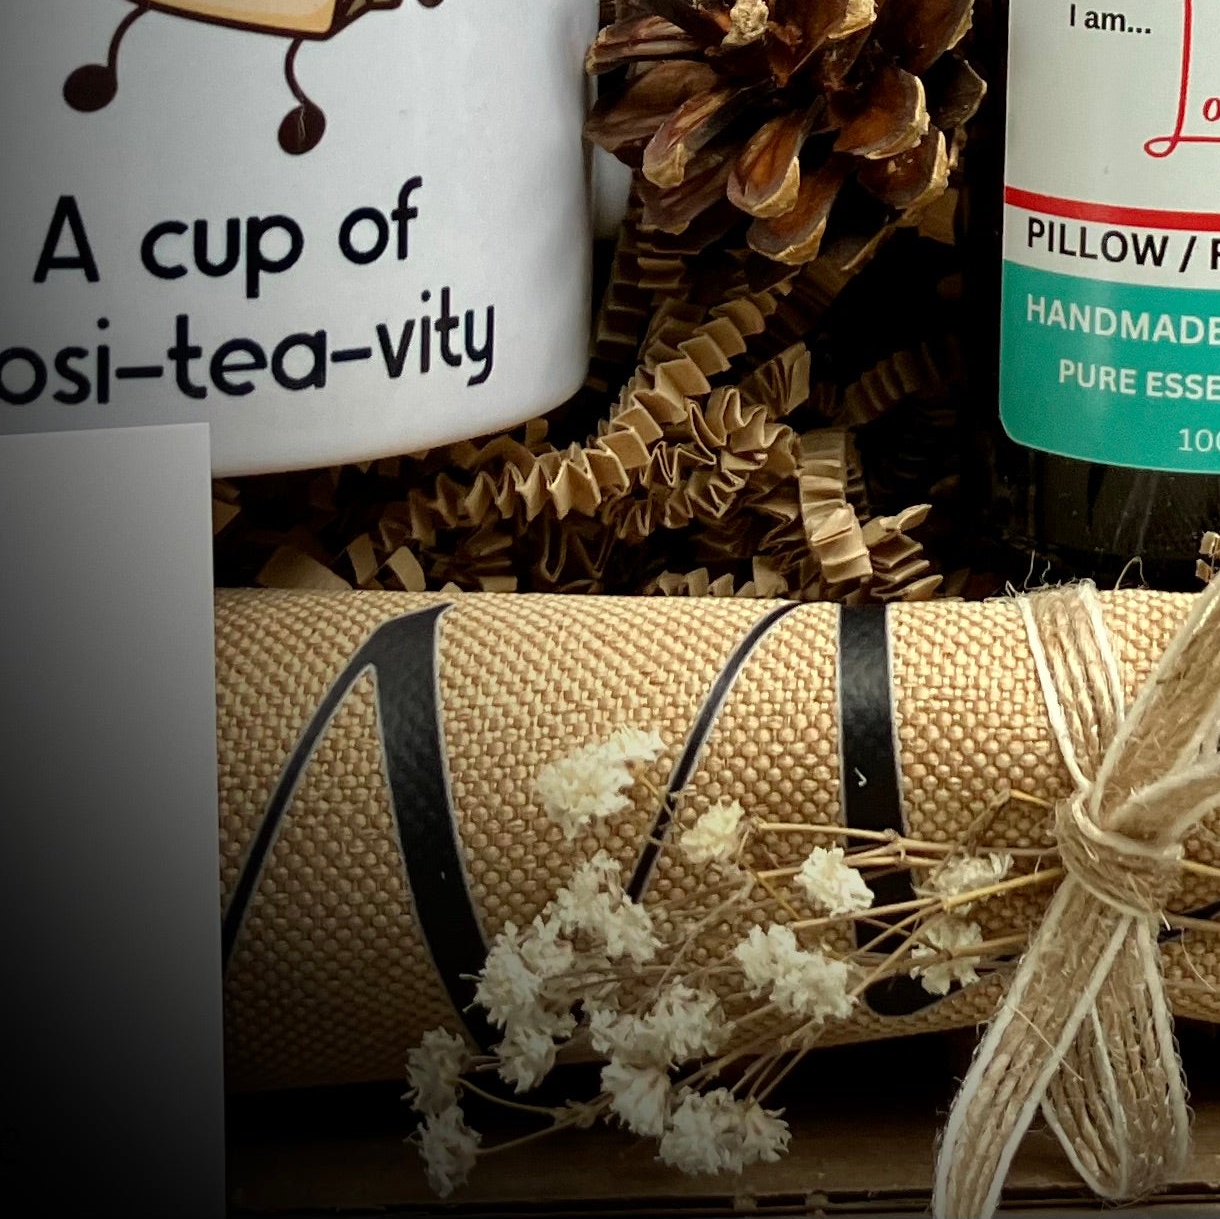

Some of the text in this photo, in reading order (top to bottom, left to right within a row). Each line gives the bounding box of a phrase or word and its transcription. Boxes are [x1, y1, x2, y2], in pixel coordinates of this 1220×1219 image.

[33, 175, 423, 299] A cup of
[1027, 216, 1169, 267] PILLOW
[1059, 359, 1137, 395] PURE
